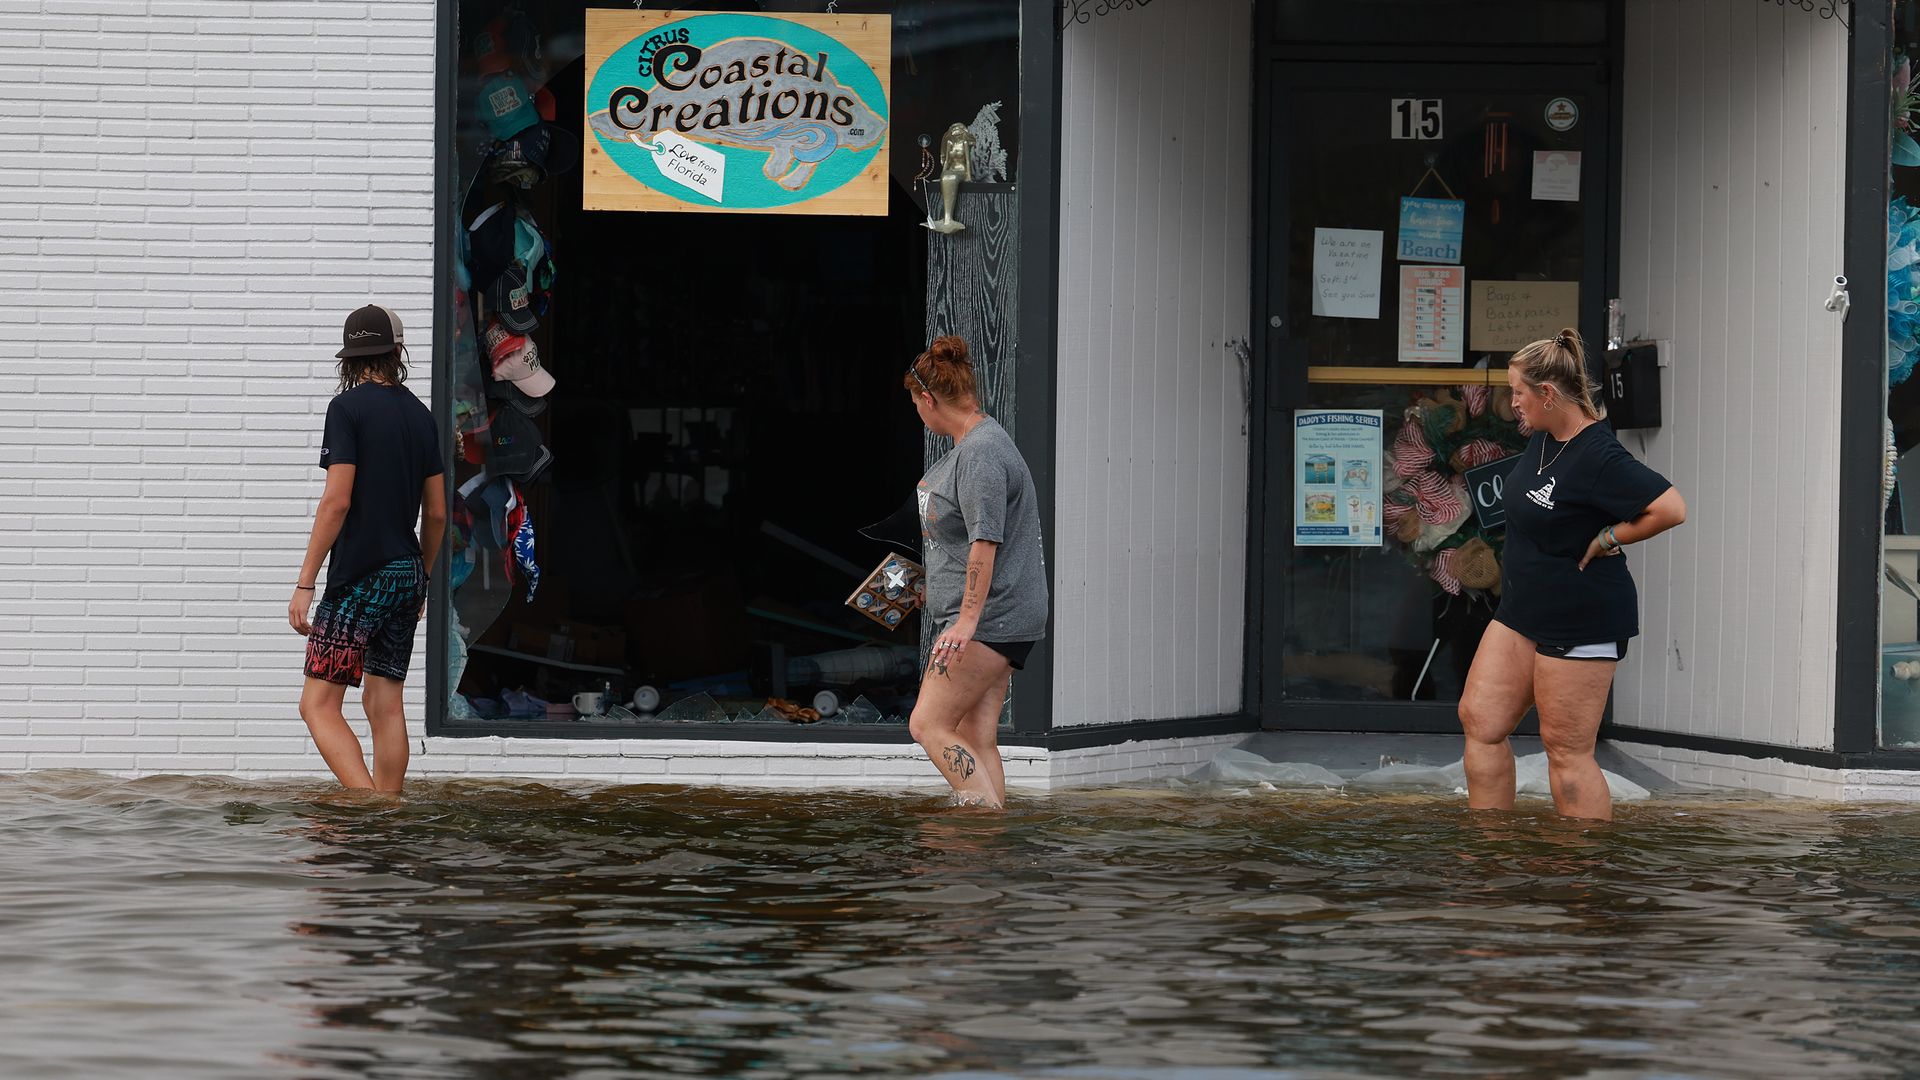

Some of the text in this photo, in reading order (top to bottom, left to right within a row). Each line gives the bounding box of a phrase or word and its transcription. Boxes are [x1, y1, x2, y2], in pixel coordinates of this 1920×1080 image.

[638, 27, 690, 77] CITRUS
[652, 43, 828, 92] Coastal
[608, 79, 855, 133] Creations
[1396, 99, 1441, 138] 15
[667, 143, 718, 176] Love from
[667, 158, 708, 187] Florida
[1339, 239, 1356, 248] are
[1401, 239, 1457, 260] Beach
[1321, 287, 1339, 299] See
[1487, 286, 1518, 306] Bags
[1488, 320, 1522, 332] Left
[1610, 372, 1624, 400] 15
[1298, 414, 1379, 426] DADDY'S FISHING SERIES
